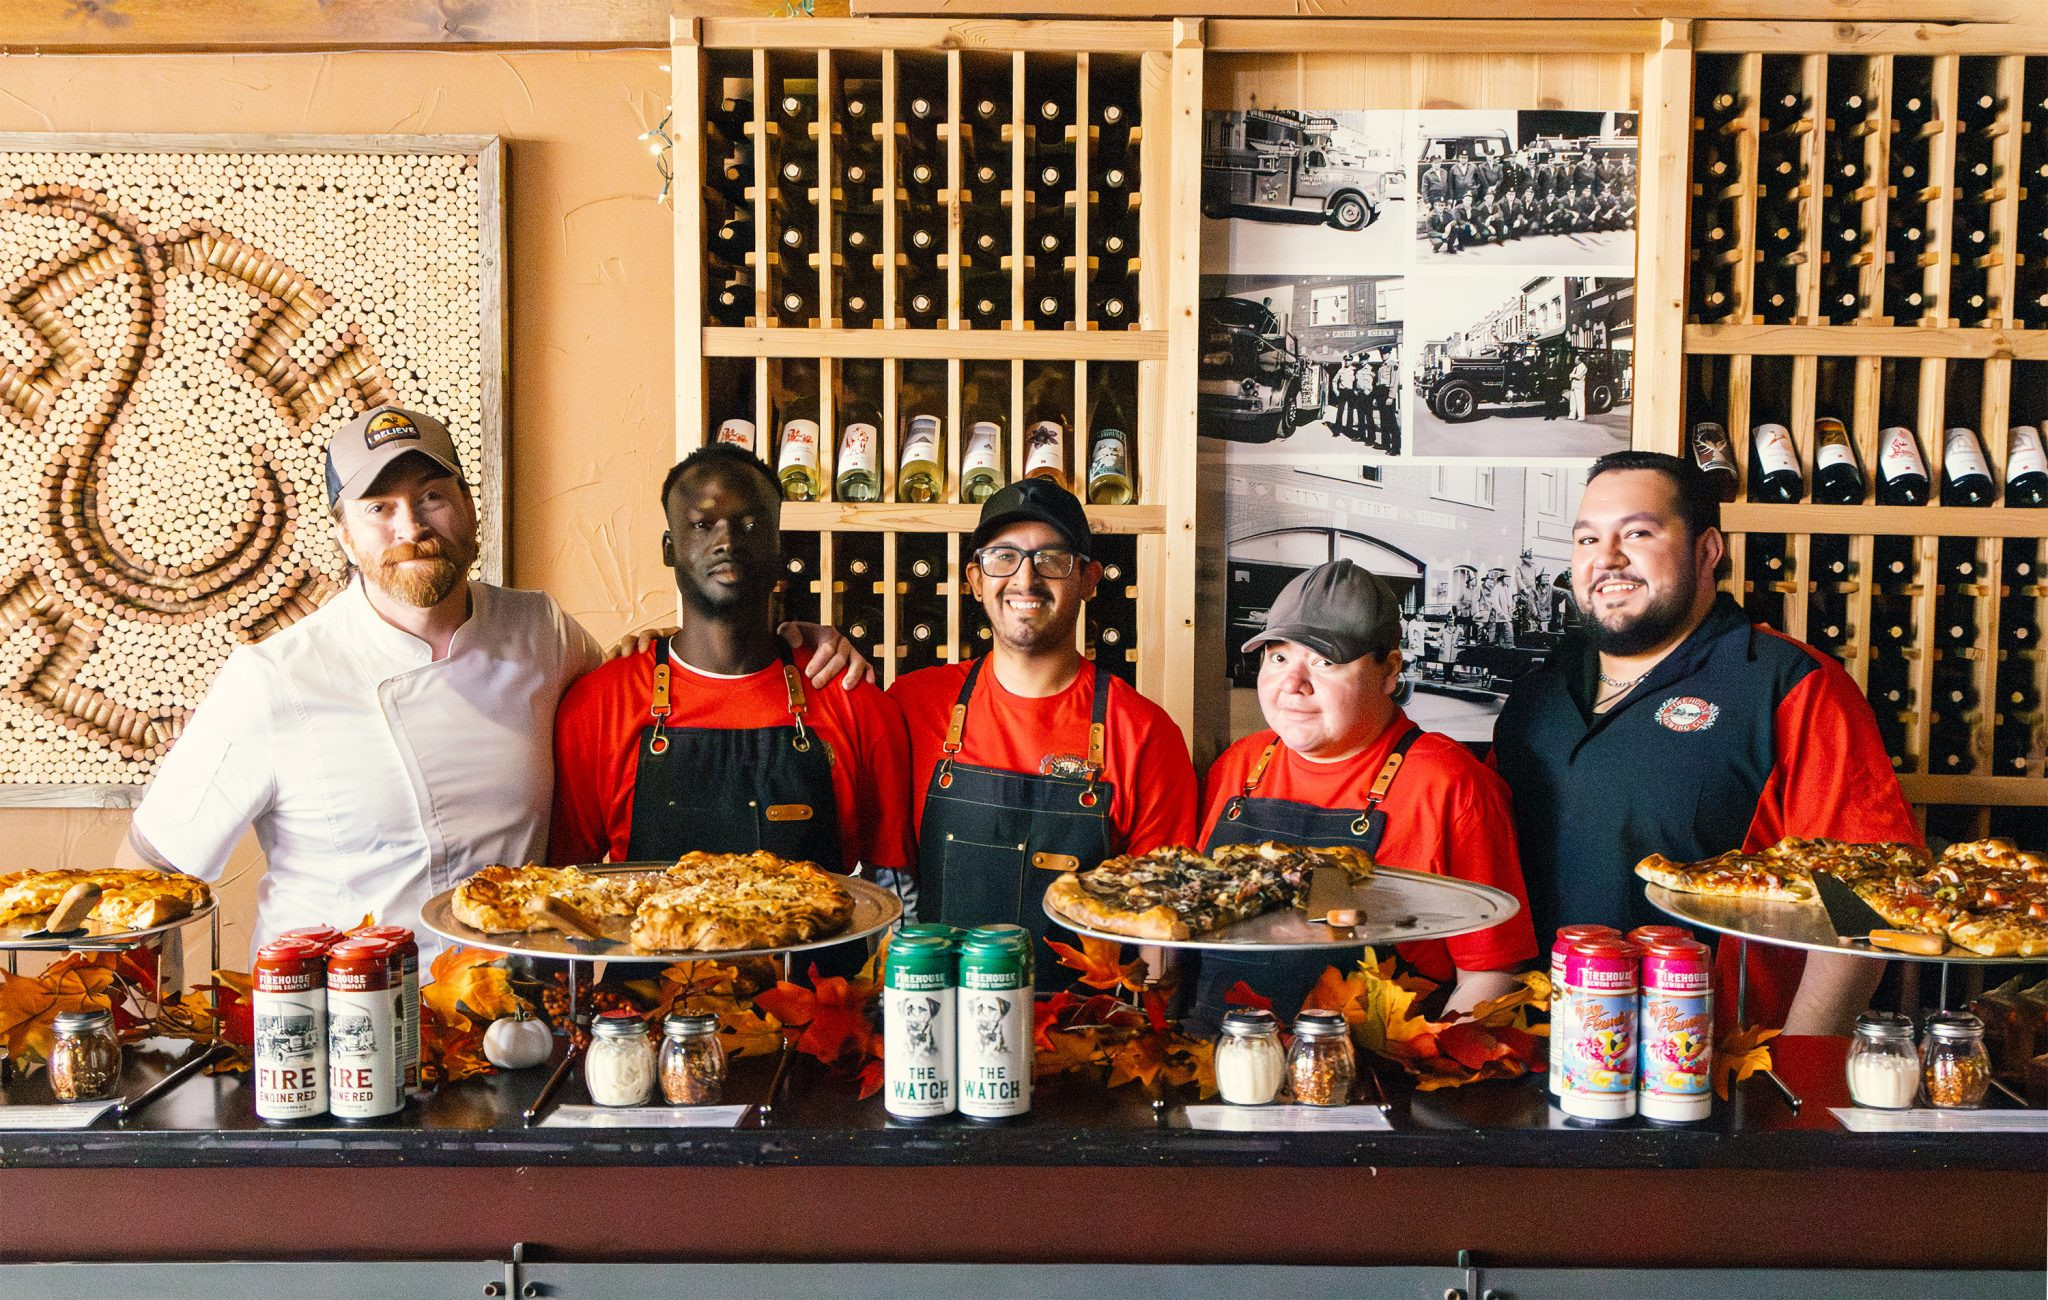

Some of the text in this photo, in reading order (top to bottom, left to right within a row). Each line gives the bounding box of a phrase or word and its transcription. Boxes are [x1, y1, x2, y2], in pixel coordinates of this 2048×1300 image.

[367, 426, 417, 445] I BELIEVE
[259, 974, 310, 985] FIREHOUSE
[328, 973, 367, 984] REHOUSE
[895, 972, 946, 983] FIREHOUSE
[965, 972, 1017, 983] FIREHOUSE
[260, 1067, 317, 1090] FIRE
[329, 1065, 373, 1089] IRE
[909, 1067, 936, 1079] THE
[978, 1066, 1006, 1079] THE
[893, 1079, 949, 1100] WATCH
[964, 1079, 1020, 1099] WATCH
[260, 1090, 317, 1103] ENGINE RED
[352, 1091, 373, 1102] RED
